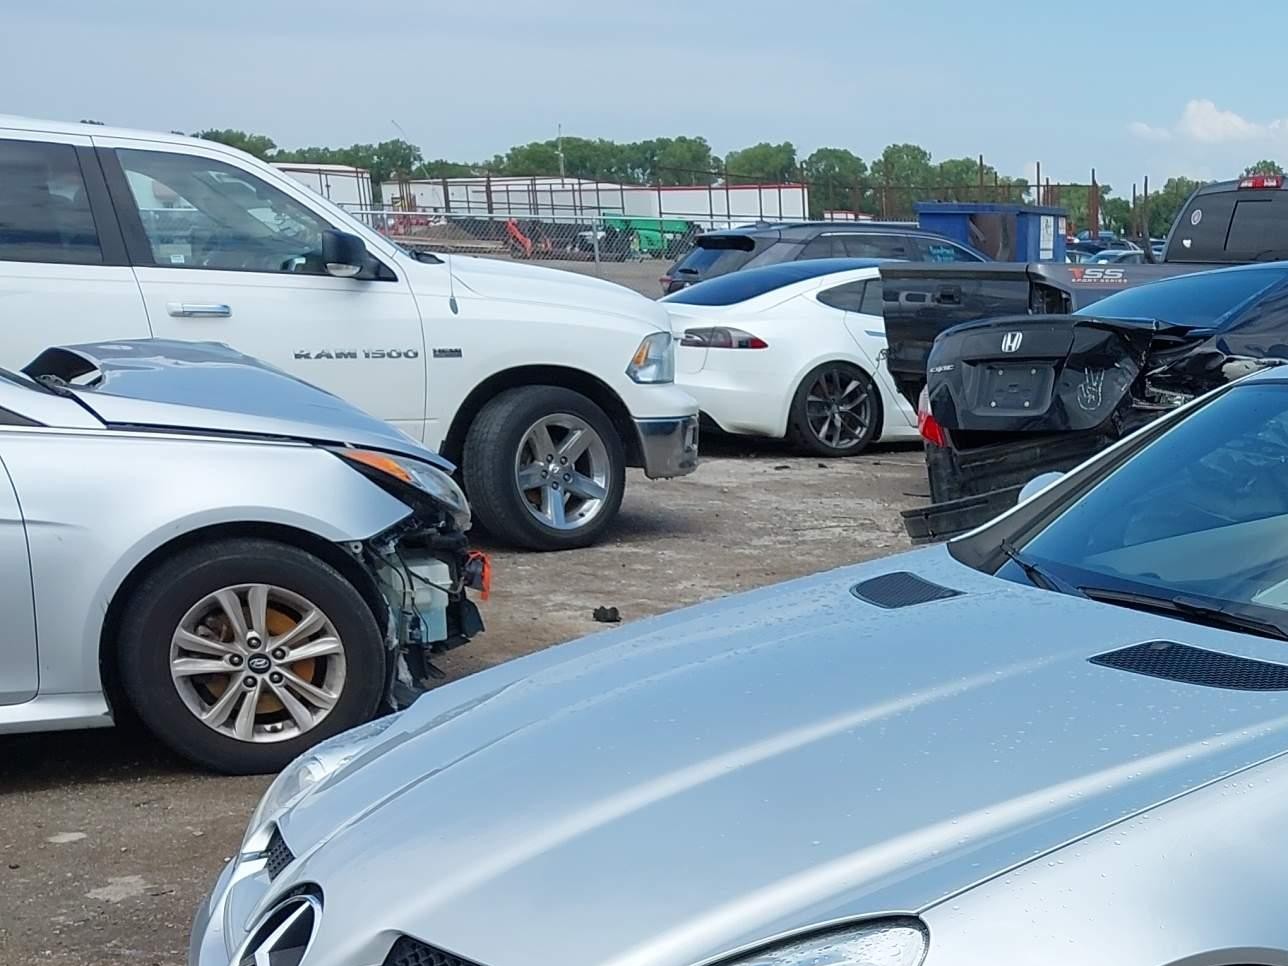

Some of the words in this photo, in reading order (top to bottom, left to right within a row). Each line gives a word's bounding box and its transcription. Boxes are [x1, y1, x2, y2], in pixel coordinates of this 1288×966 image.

[1067, 267, 1125, 281] TSS
[294, 350, 357, 360] RAM
[362, 349, 419, 359] 1500
